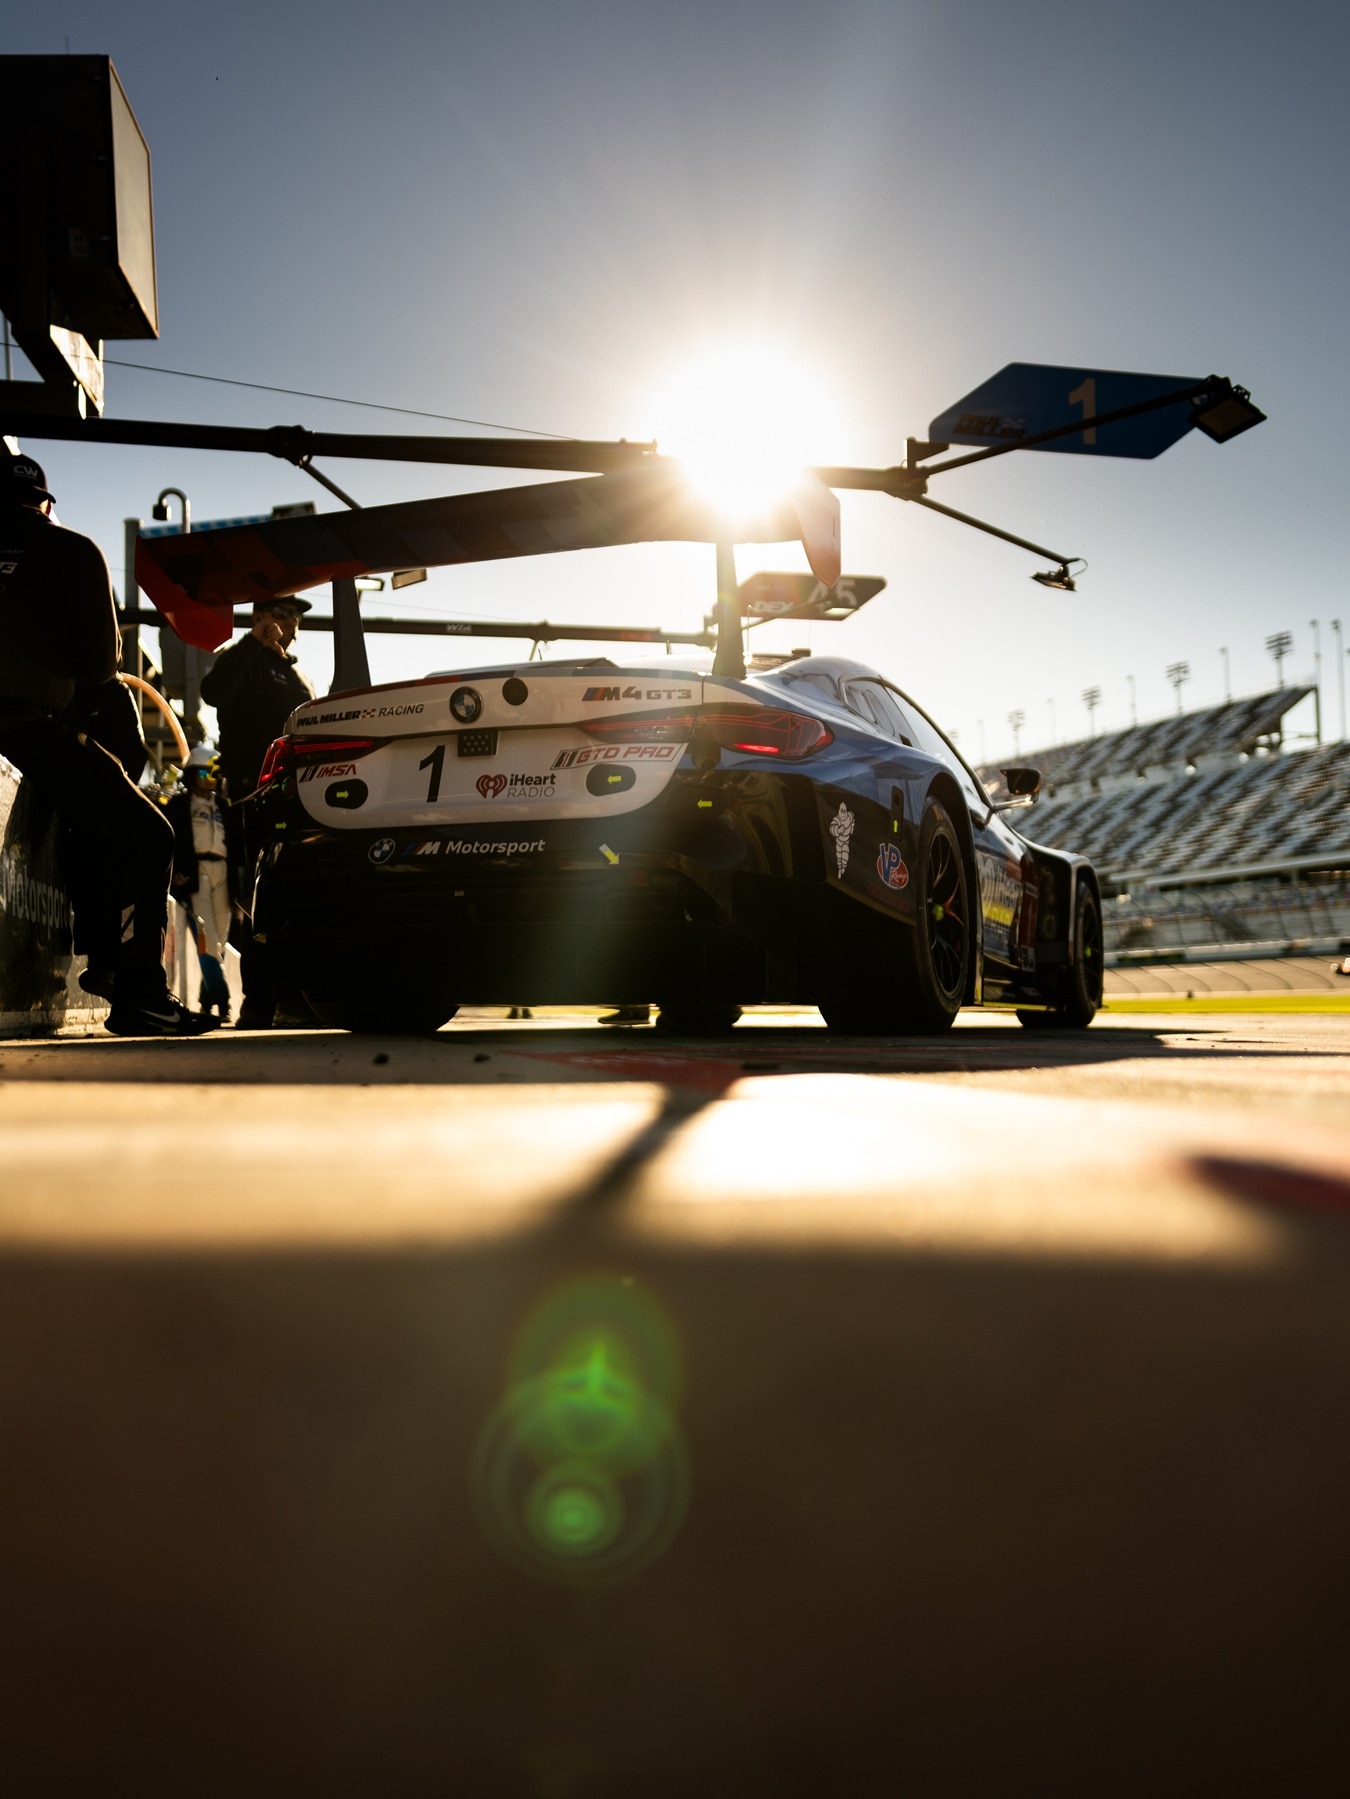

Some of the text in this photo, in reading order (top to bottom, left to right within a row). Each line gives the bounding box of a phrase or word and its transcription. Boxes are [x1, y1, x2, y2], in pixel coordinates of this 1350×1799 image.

[1068, 377, 1097, 445] 1
[646, 689, 692, 700] GT3
[296, 704, 425, 728] PAUL MILLER RACING
[576, 746, 675, 764] GTD PRO
[316, 764, 357, 778] IMSA
[419, 745, 446, 803] 1
[509, 773, 557, 786] iHeart
[507, 786, 556, 798] RADIO
[445, 839, 546, 857] Motorsport
[879, 842, 902, 887] VP
